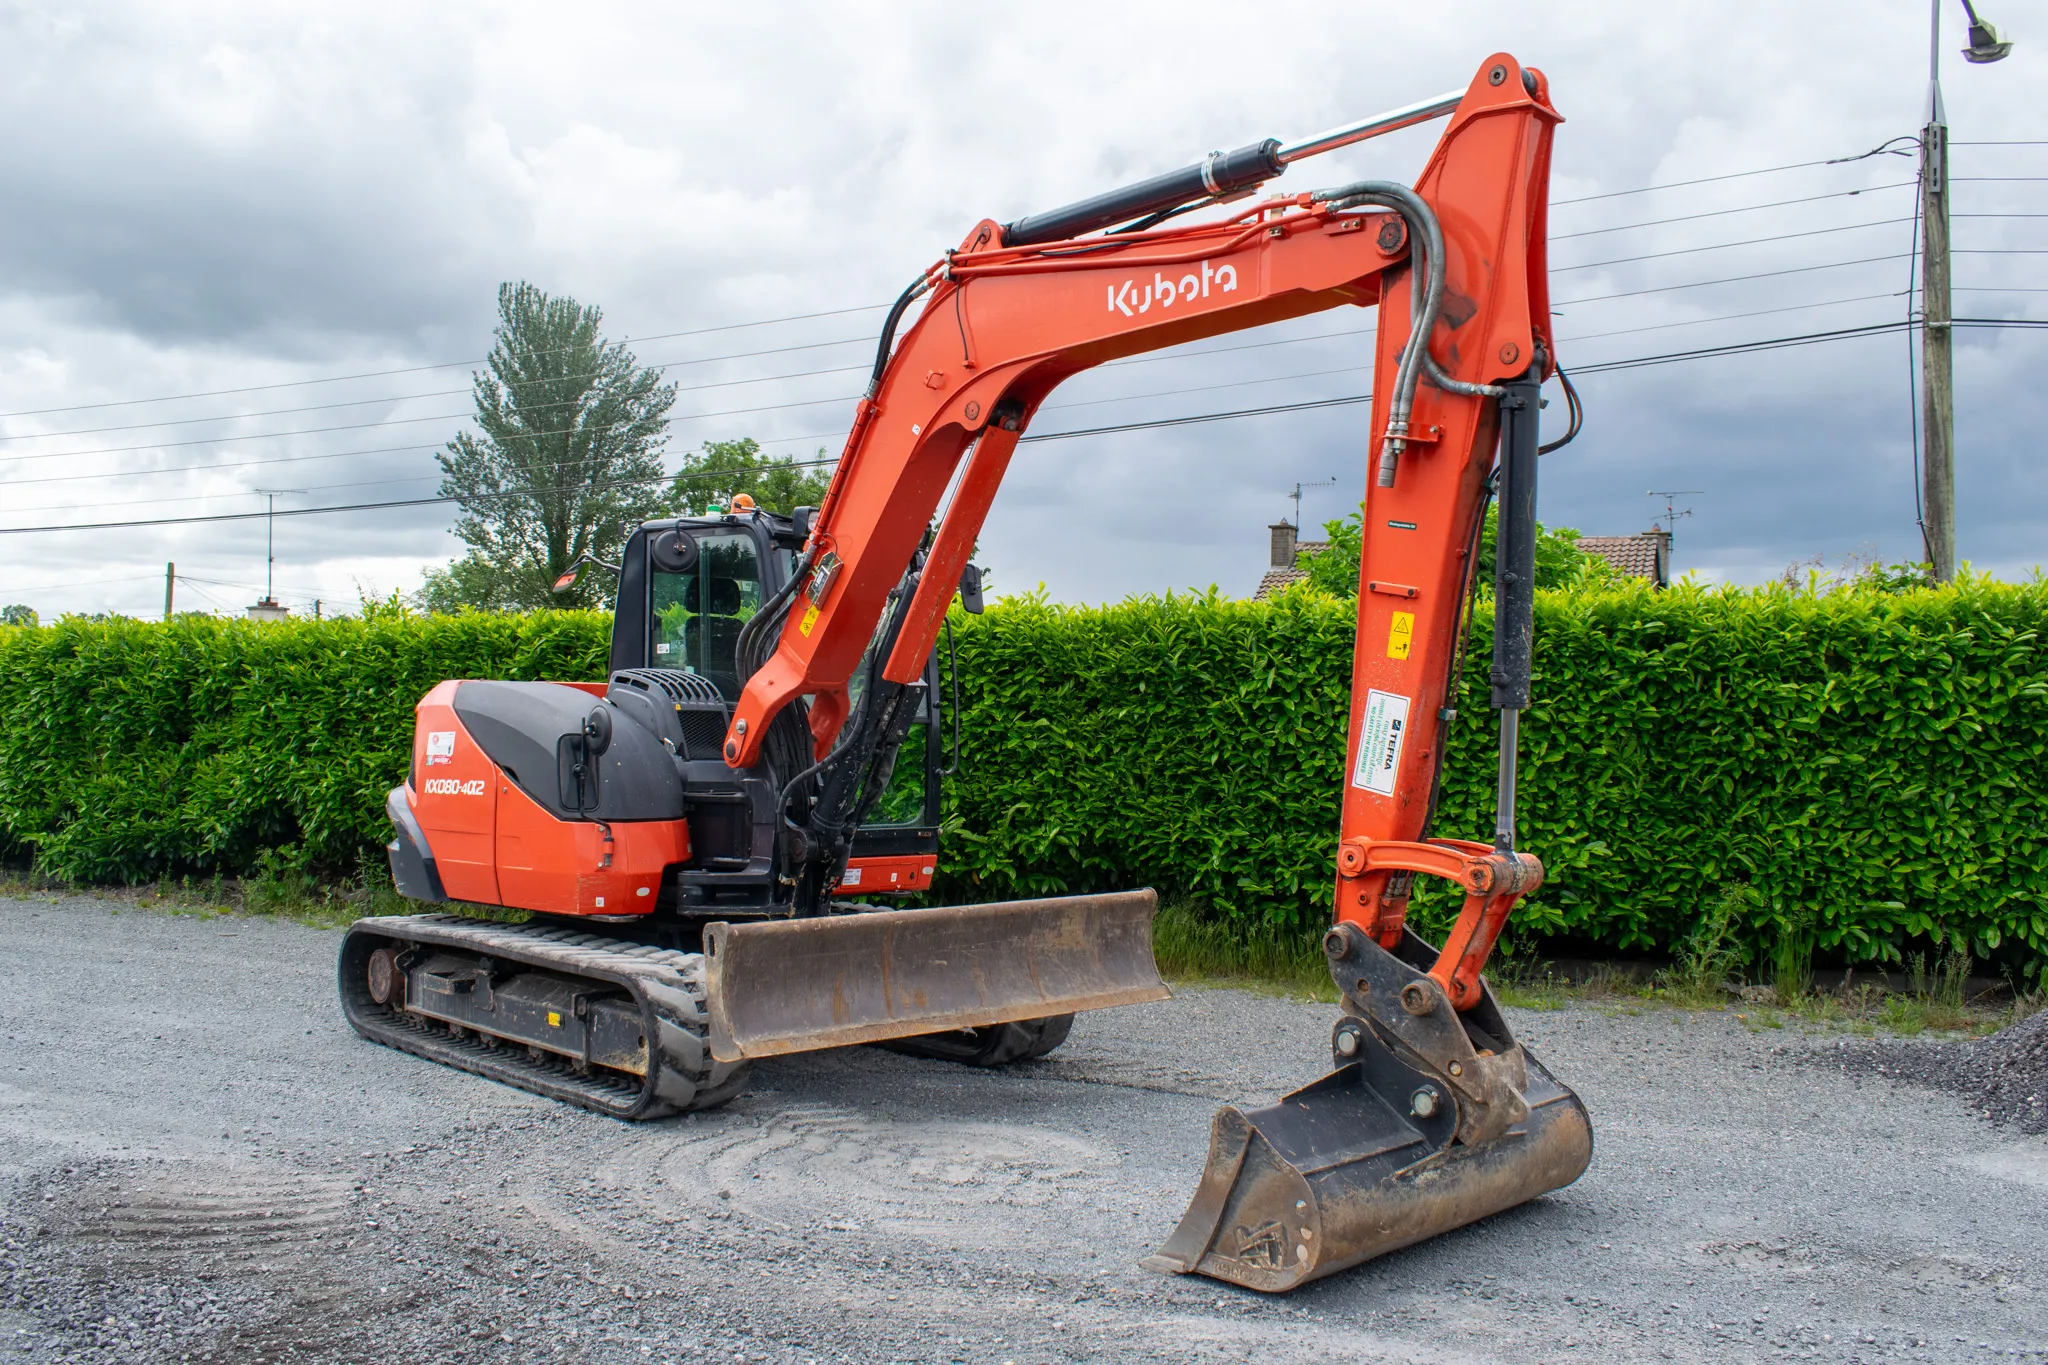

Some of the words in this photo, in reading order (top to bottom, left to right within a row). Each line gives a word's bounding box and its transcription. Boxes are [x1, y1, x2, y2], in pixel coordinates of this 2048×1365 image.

[1107, 259, 1237, 317] Kubota
[1367, 715, 1375, 735] SAFETY
[1360, 745, 1370, 773] REQUIRED
[1376, 737, 1387, 766] AUTOMATIC
[1384, 733, 1397, 770] TEFRA
